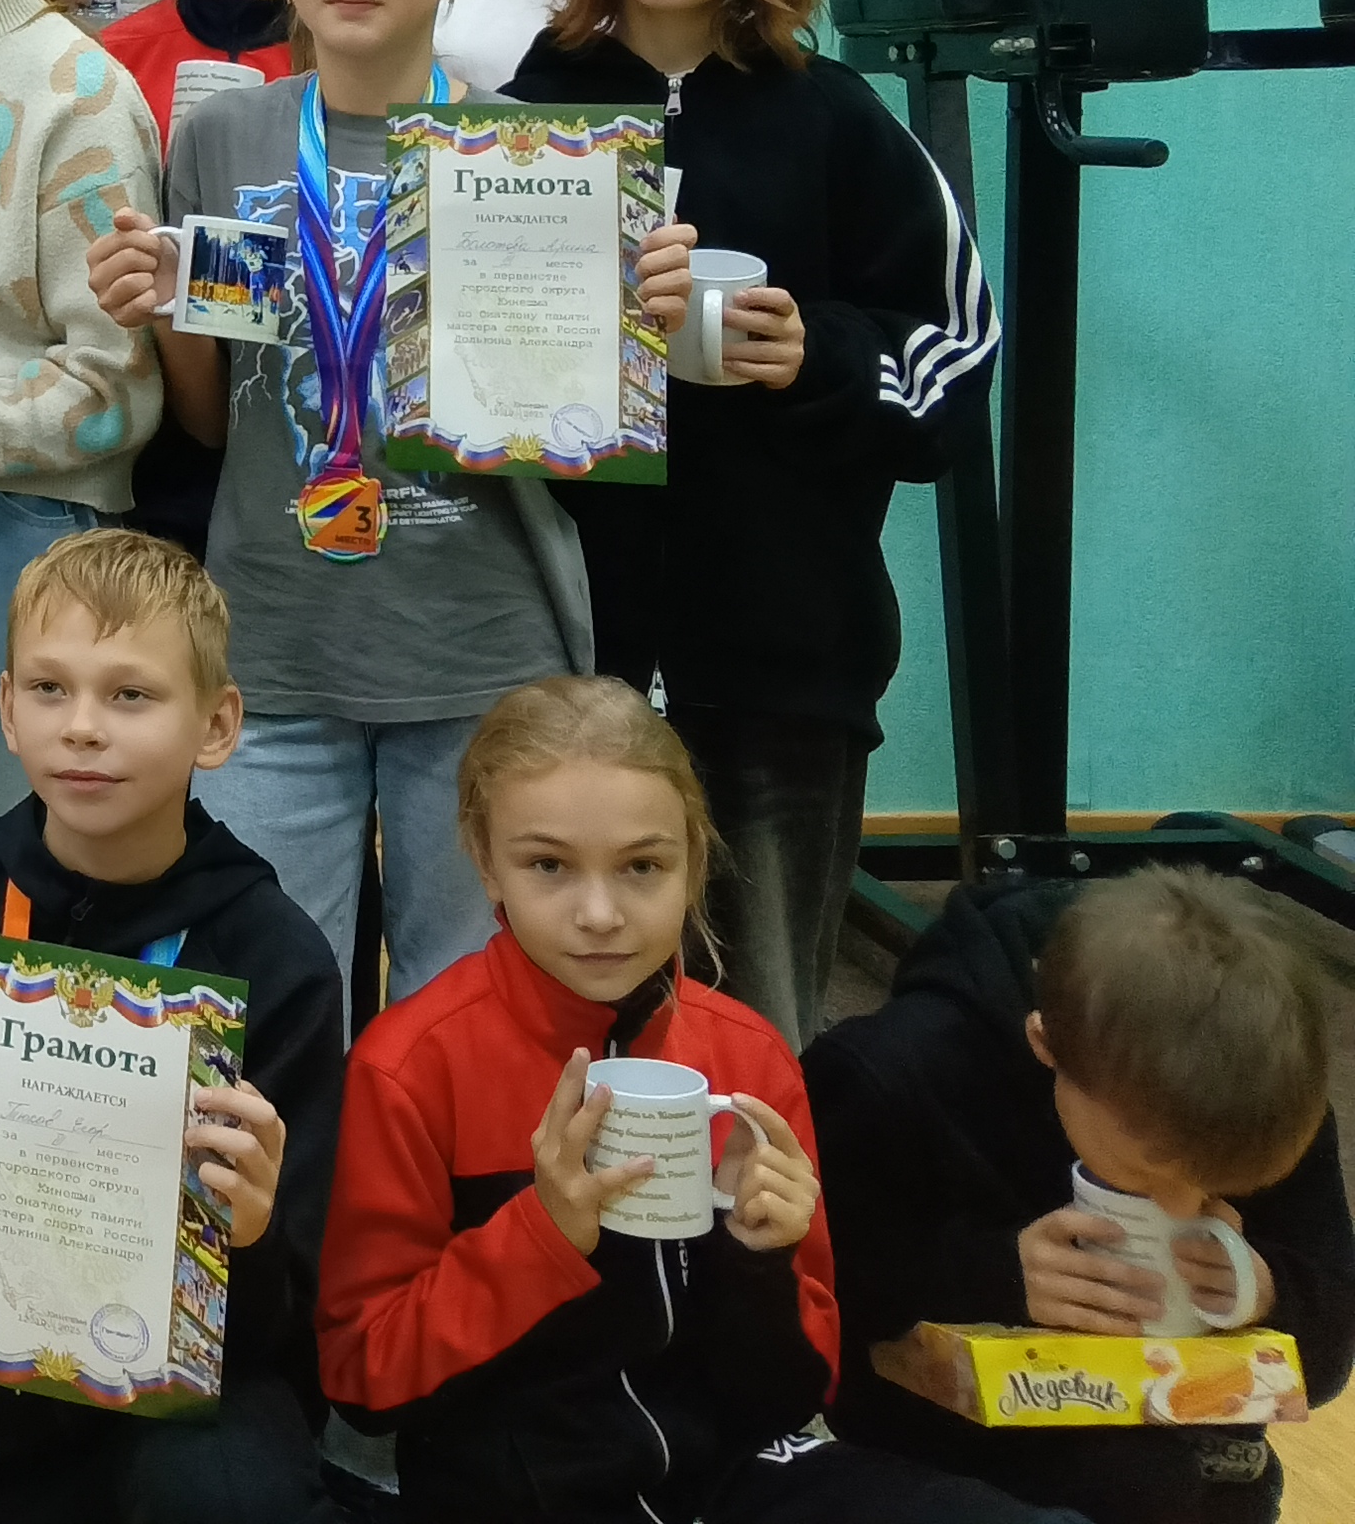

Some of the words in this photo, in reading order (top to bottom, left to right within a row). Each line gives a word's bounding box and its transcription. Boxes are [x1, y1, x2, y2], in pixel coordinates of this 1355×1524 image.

[453, 169, 593, 201] Грамота
[475, 213, 568, 225] НАГРАЖДАЕТСЯ
[462, 258, 478, 267] за
[546, 260, 584, 270] место
[493, 272, 568, 282] первенстве
[461, 284, 534, 296] городского
[541, 286, 586, 296] округа
[458, 310, 472, 319] по
[479, 309, 538, 321] биатлону
[545, 313, 590, 322] памяти
[446, 323, 498, 333] мастера
[504, 325, 549, 336] спорта
[556, 325, 601, 336] России
[519, 337, 594, 350] Александра
[354, 505, 372, 533] 3
[0, 1017, 158, 1077] Грамота
[21, 1077, 127, 1108] НАГРАЖДАЕТСЯ
[2, 1129, 18, 1141] за
[96, 1148, 140, 1164] место
[19, 1149, 27, 1158] в
[35, 1151, 120, 1176] первенстве
[36, 1182, 96, 1204] Кинешма
[88, 1179, 140, 1196] округа
[15, 1194, 83, 1218] биатлону
[91, 1210, 143, 1229] памяти
[43, 1217, 94, 1236] спорта
[103, 1228, 154, 1248] России
[58, 1236, 144, 1263] Александра
[998, 1370, 1131, 1417] Медовик
